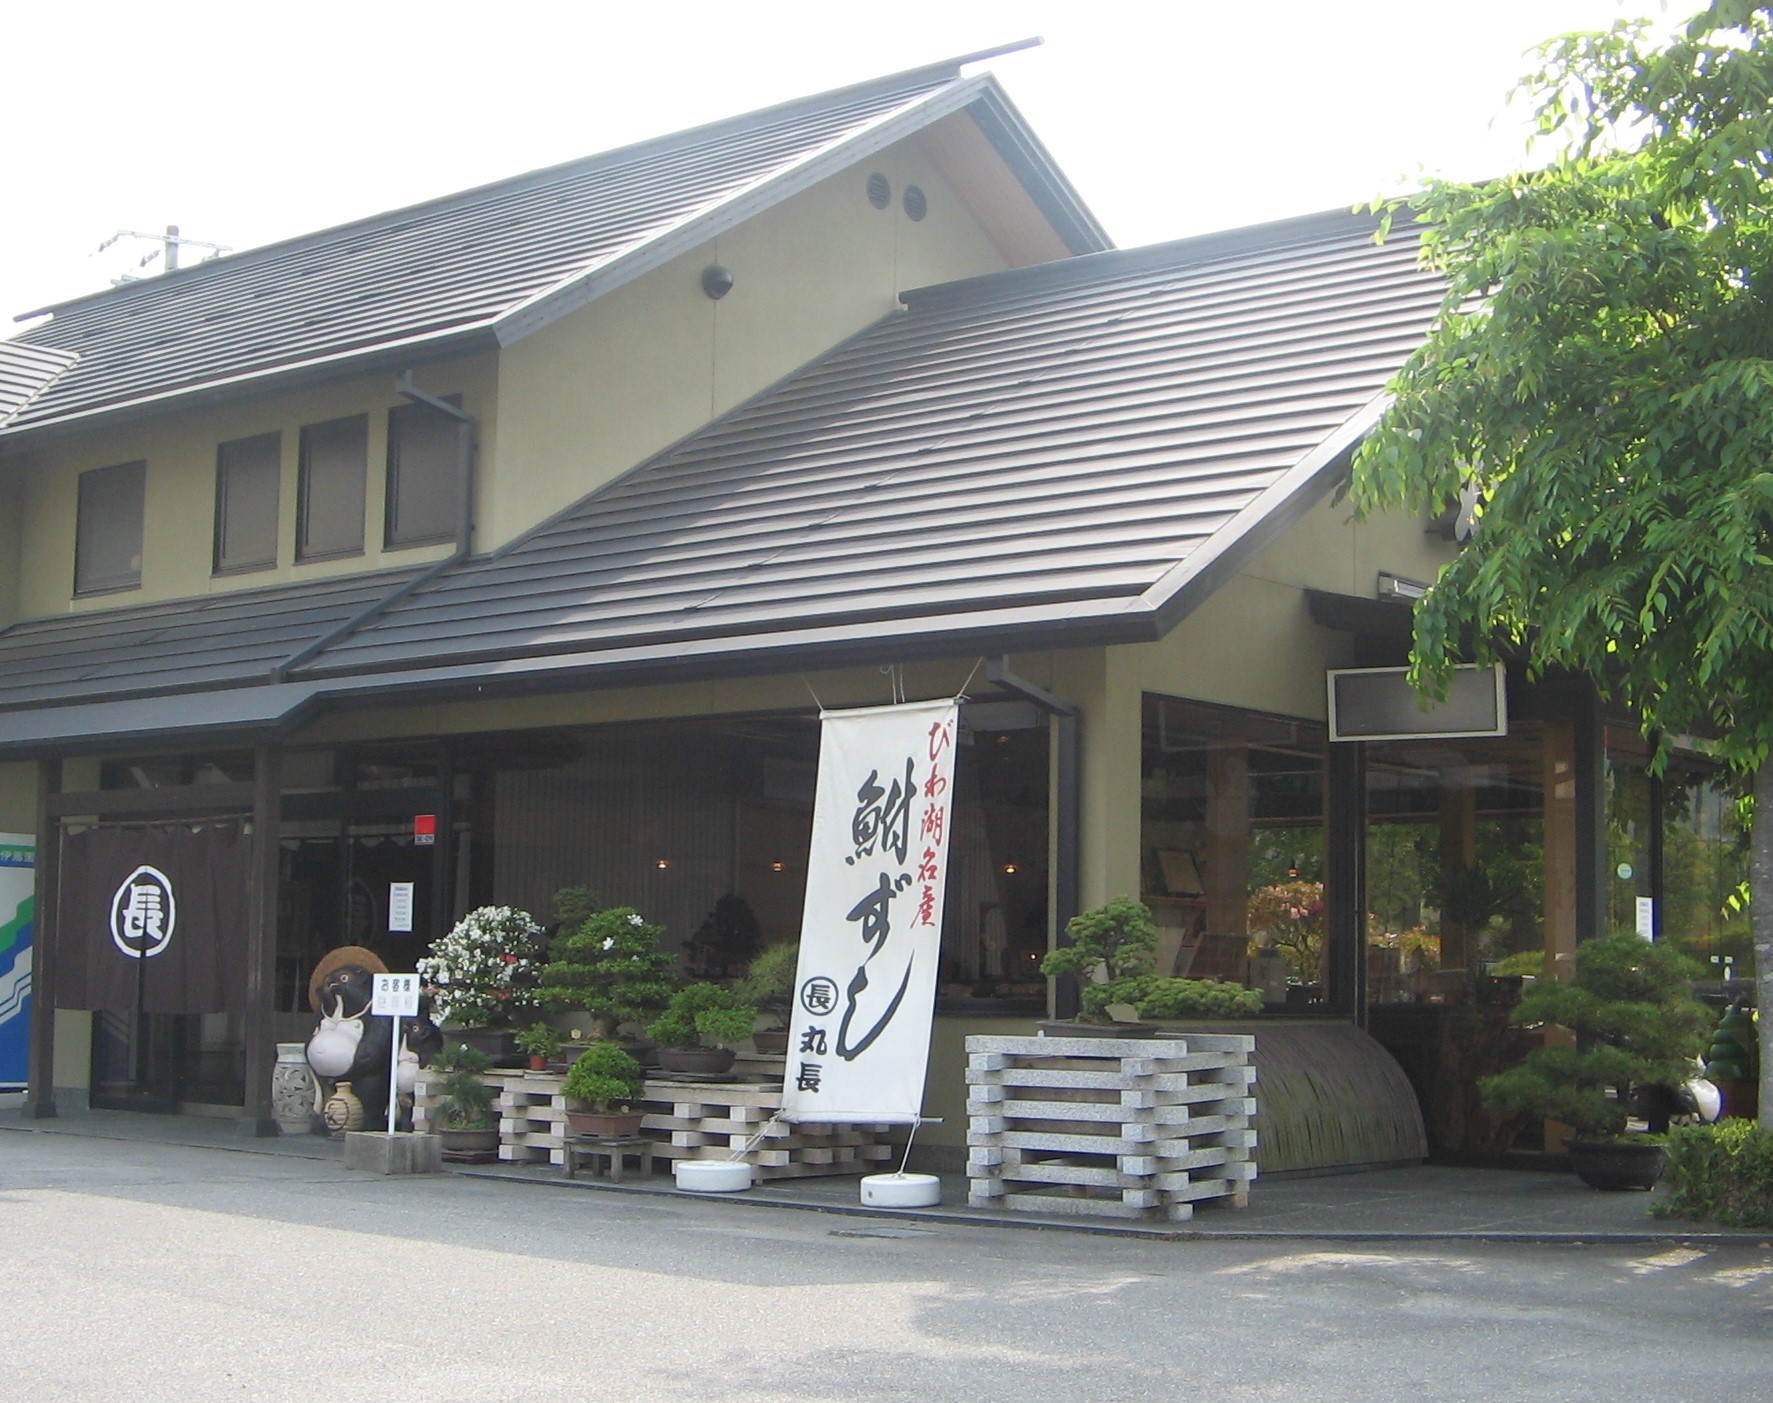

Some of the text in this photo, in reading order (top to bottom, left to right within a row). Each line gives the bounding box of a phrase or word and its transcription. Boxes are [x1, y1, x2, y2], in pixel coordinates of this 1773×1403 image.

[909, 719, 954, 929] びわ湖名産
[122, 883, 164, 940] 長
[804, 982, 834, 1012] 長
[796, 1025, 827, 1093] 丸長
